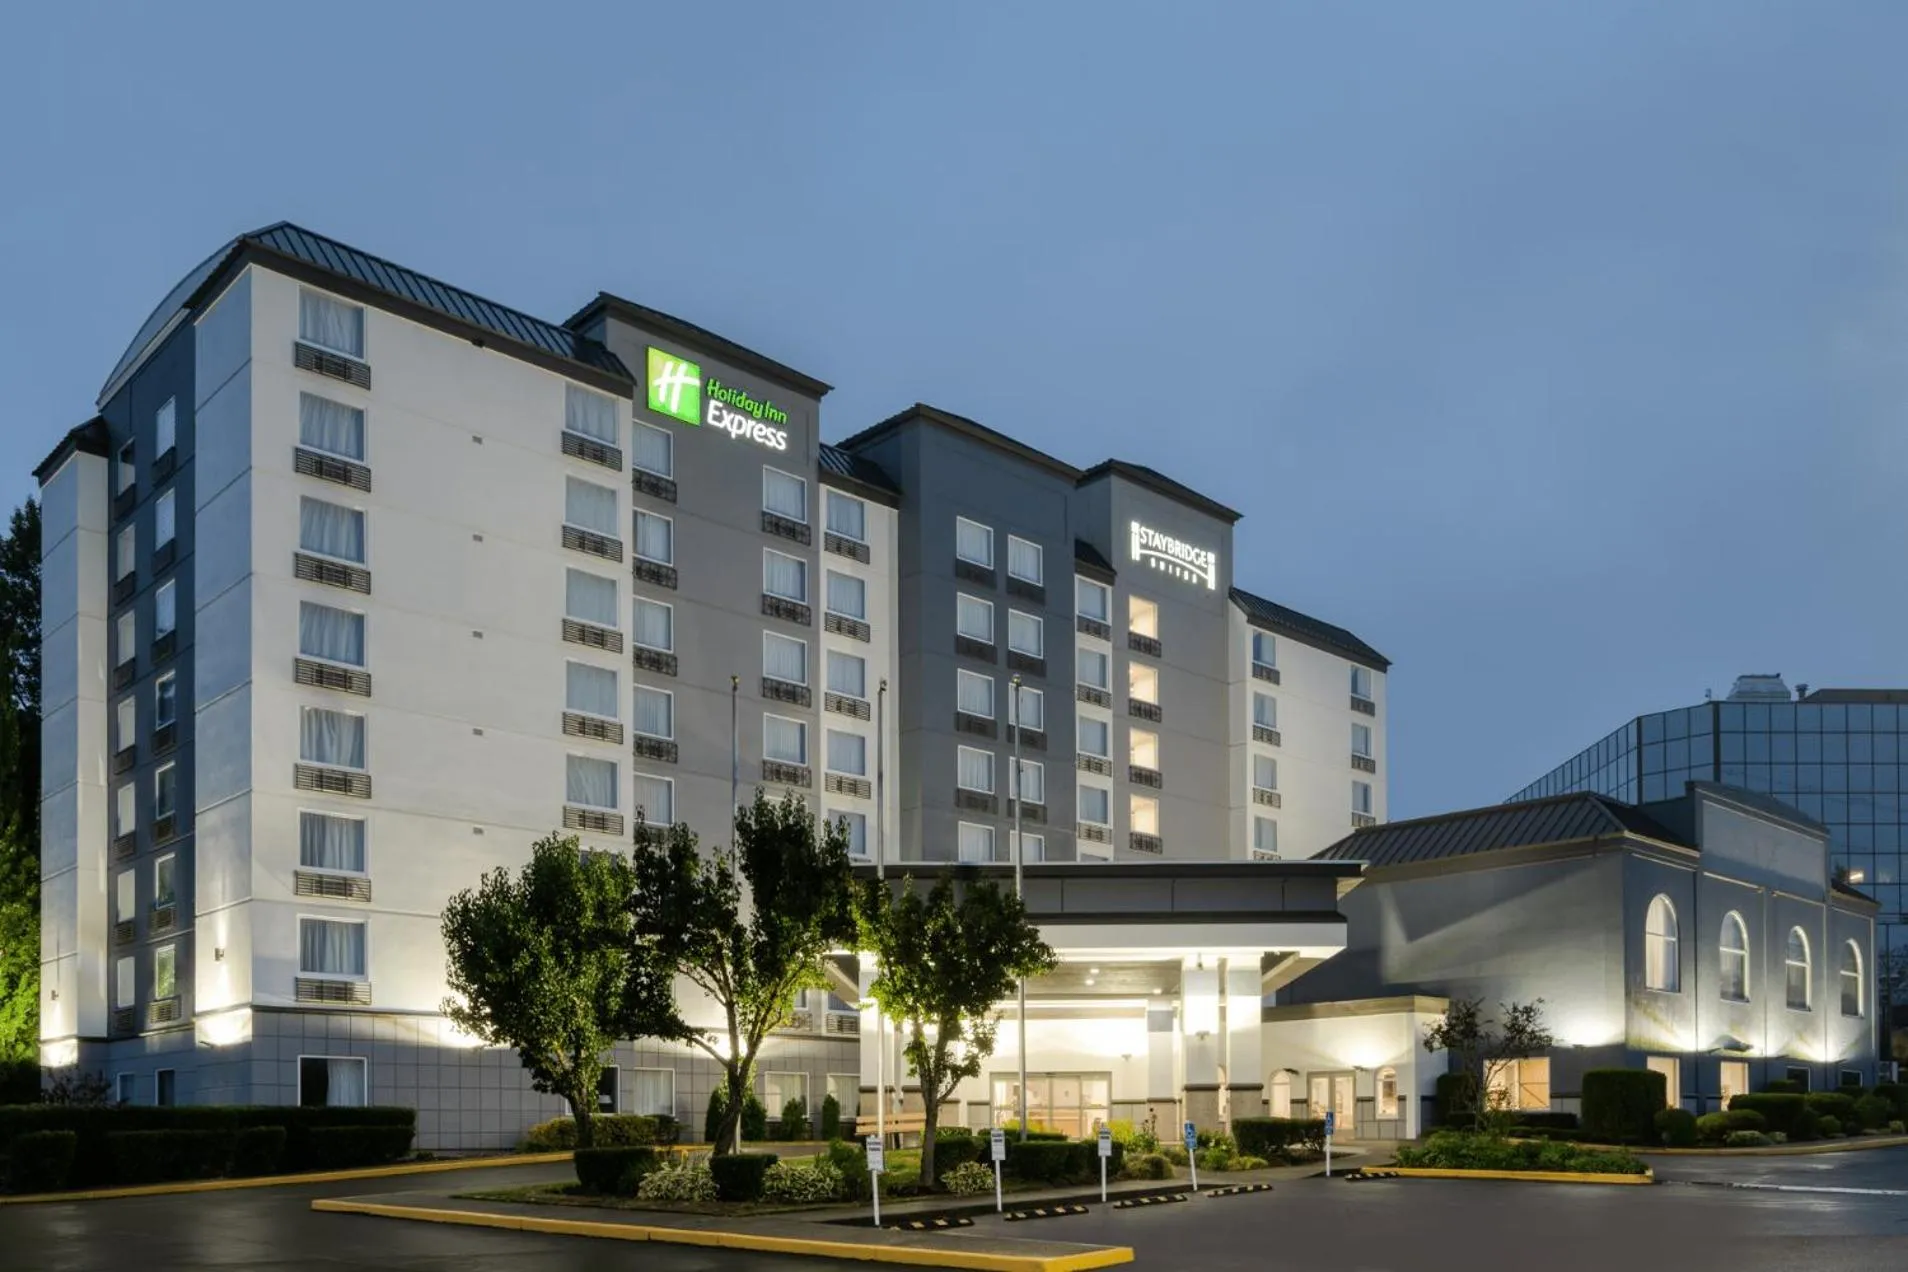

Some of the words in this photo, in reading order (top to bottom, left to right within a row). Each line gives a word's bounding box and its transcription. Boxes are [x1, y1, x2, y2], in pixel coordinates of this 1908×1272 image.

[707, 378, 763, 418] Holiday
[764, 401, 787, 424] Inn
[707, 399, 787, 451] Express
[1140, 526, 1207, 568] STAYBRIDGE
